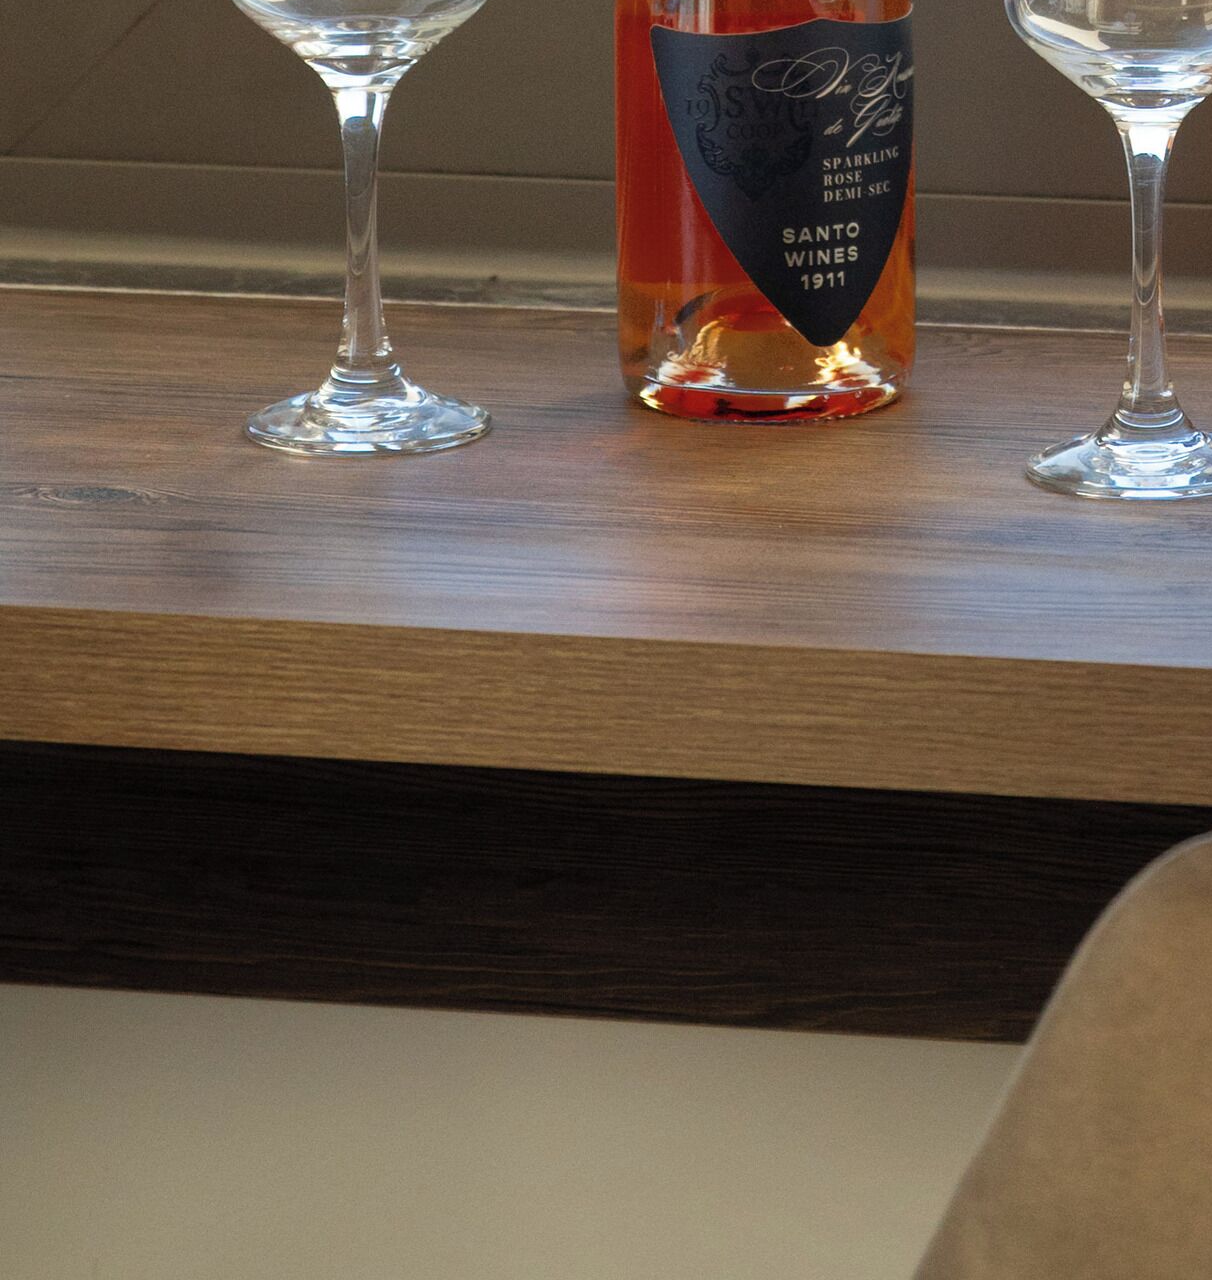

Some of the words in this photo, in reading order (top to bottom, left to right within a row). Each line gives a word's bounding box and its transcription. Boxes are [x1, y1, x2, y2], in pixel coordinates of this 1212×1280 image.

[684, 98, 710, 120] 19
[823, 118, 843, 136] de
[823, 146, 899, 171] SPARKLING
[823, 170, 863, 187] ROSE
[823, 180, 891, 202] DEMI-SEC
[782, 222, 860, 244] SANTO
[784, 246, 859, 268] WINES
[800, 271, 845, 290] 1911
